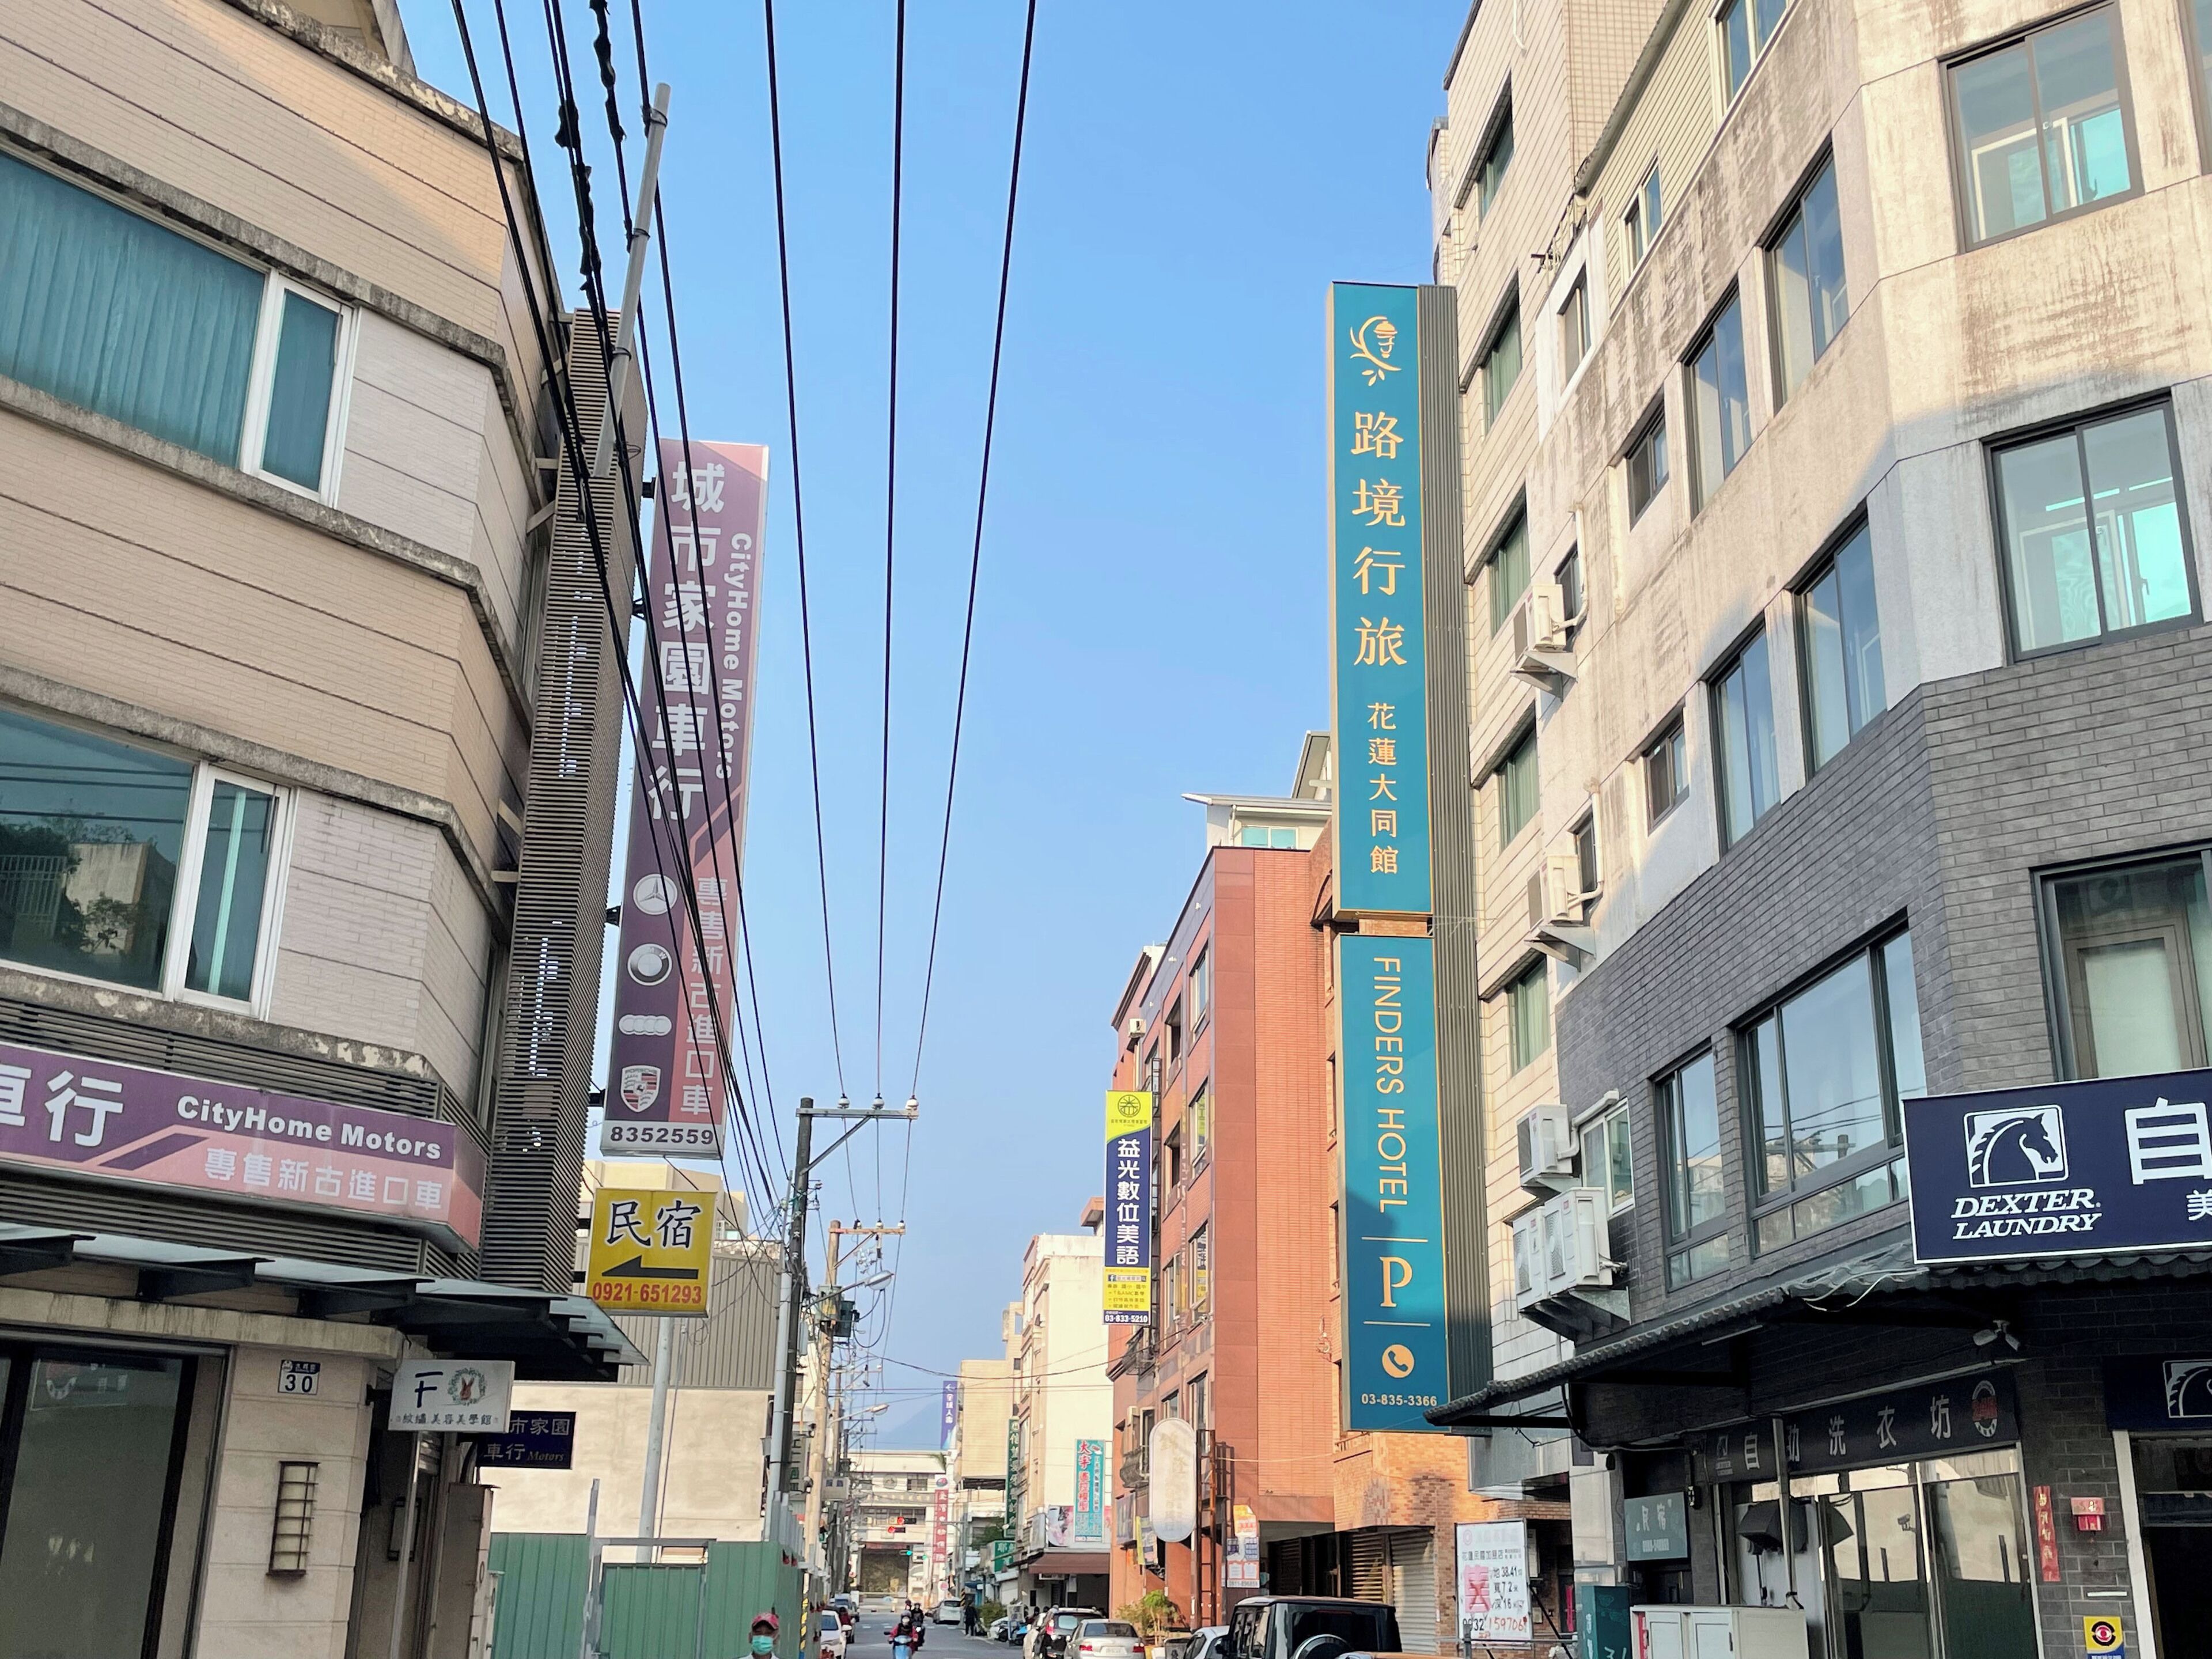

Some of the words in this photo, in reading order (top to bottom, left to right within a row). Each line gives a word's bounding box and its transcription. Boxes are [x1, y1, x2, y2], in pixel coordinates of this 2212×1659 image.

[1350, 411, 1408, 667] 路境行旅
[724, 532, 752, 671] CityHome
[649, 461, 726, 821] 城市家園車行
[715, 678, 743, 779] Motors
[1367, 702, 1400, 874] 花蓮大同館
[1373, 956, 1405, 1094] FINDERS
[177, 1096, 332, 1142] CityHome
[340, 1123, 441, 1160] Motors
[609, 1126, 714, 1145] 8352559
[1377, 1108, 1408, 1214] HOTEL
[2124, 1097, 2212, 1185] 自
[203, 1146, 443, 1210] 專售新古進口車
[1116, 1138, 1141, 1265] 益光數位美語
[607, 1200, 701, 1249] 民宿
[1952, 1212, 2103, 1240] LAUNDRY
[1378, 1256, 1413, 1308] P
[285, 1374, 313, 1393] 30
[1361, 1393, 1438, 1407] 03-835-3366
[483, 1442, 526, 1461] 車行
